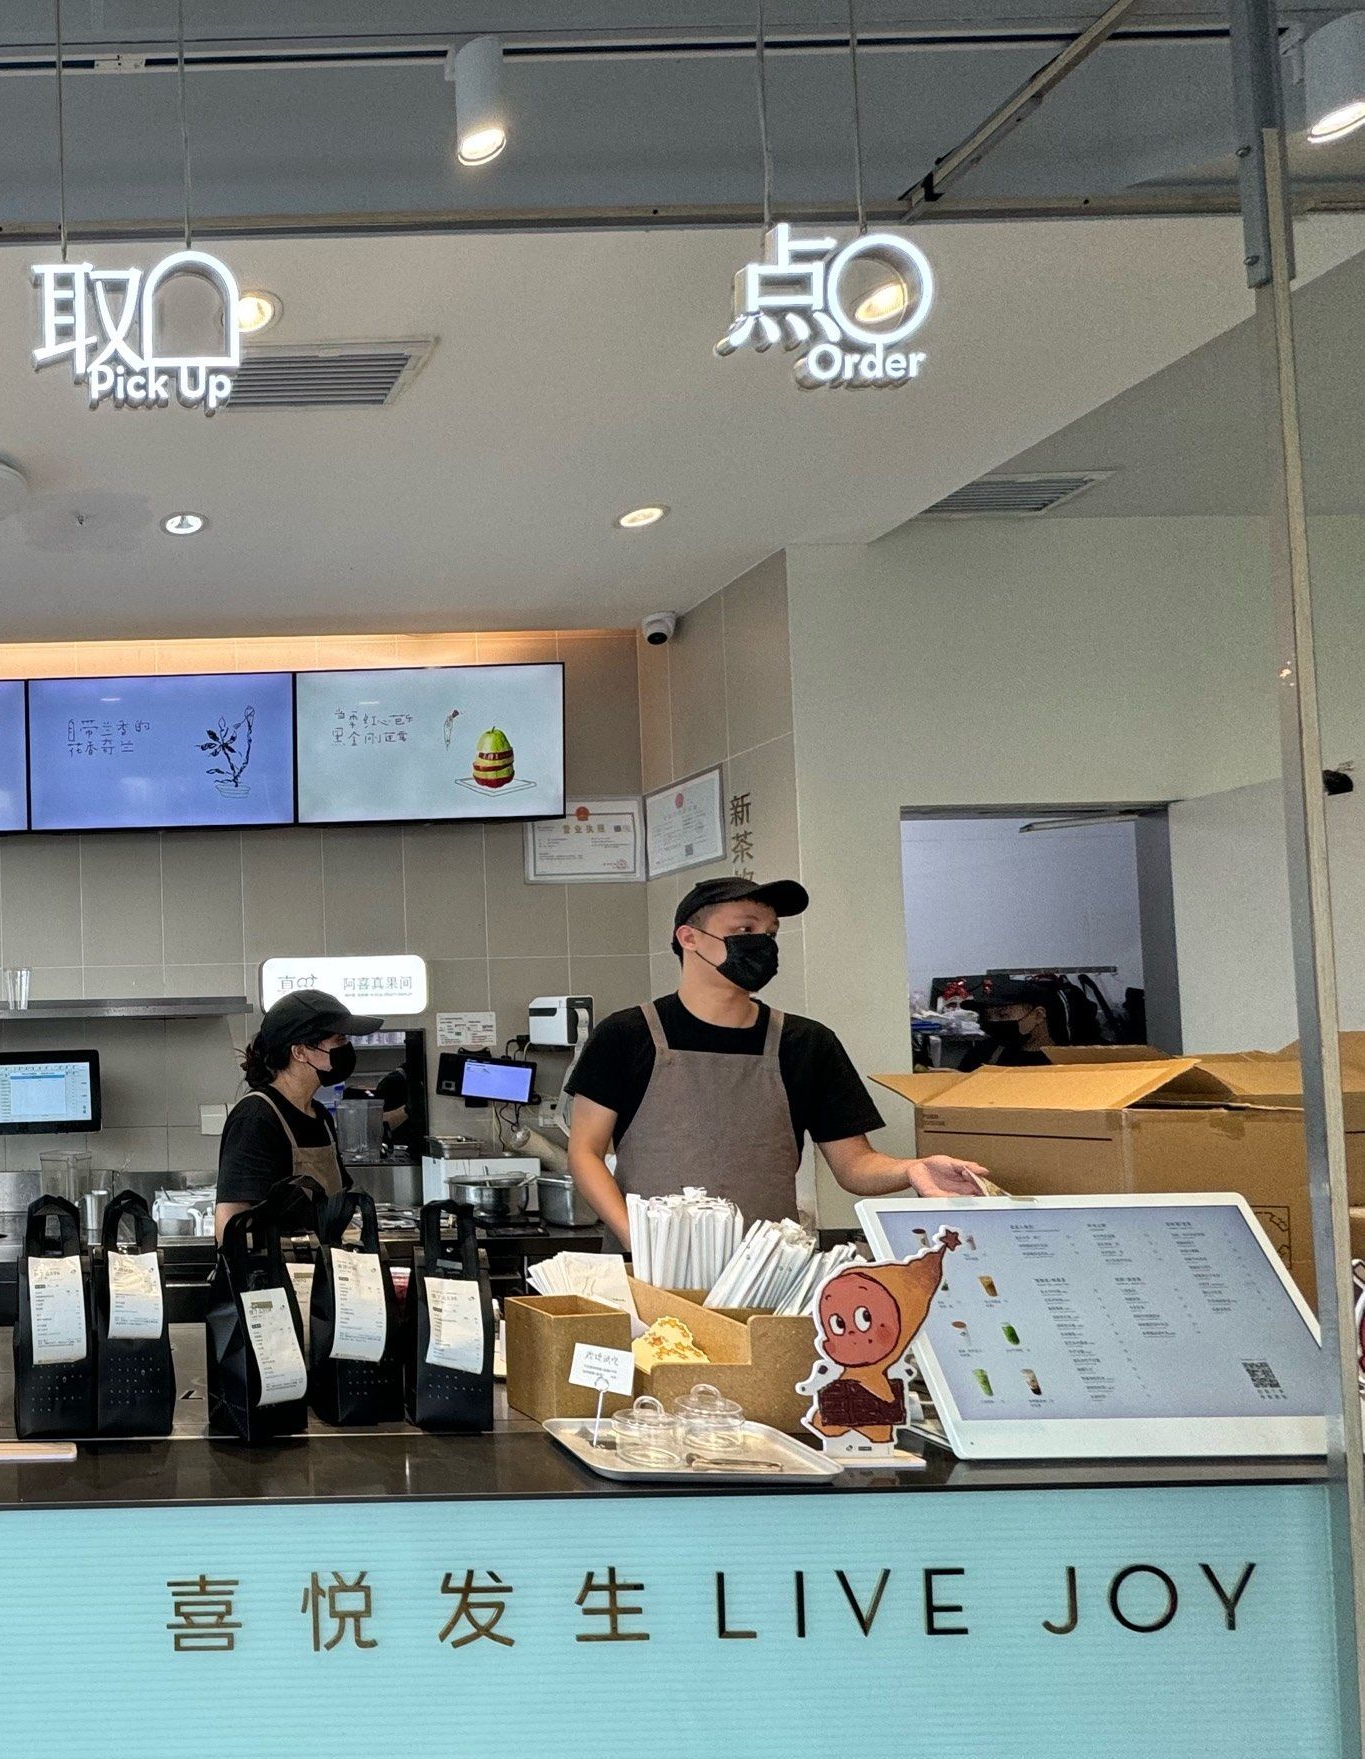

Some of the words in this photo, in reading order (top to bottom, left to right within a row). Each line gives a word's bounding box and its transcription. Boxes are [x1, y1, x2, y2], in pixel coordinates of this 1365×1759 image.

[90, 364, 169, 402] Pick
[179, 364, 233, 409] Up
[807, 343, 927, 380] Order
[729, 792, 754, 880] 新茶
[343, 976, 413, 990] 阿喜真果间
[166, 1566, 651, 1652] 喜悦发生
[716, 1567, 970, 1640] LIVE
[1041, 1561, 1257, 1636] JOY
